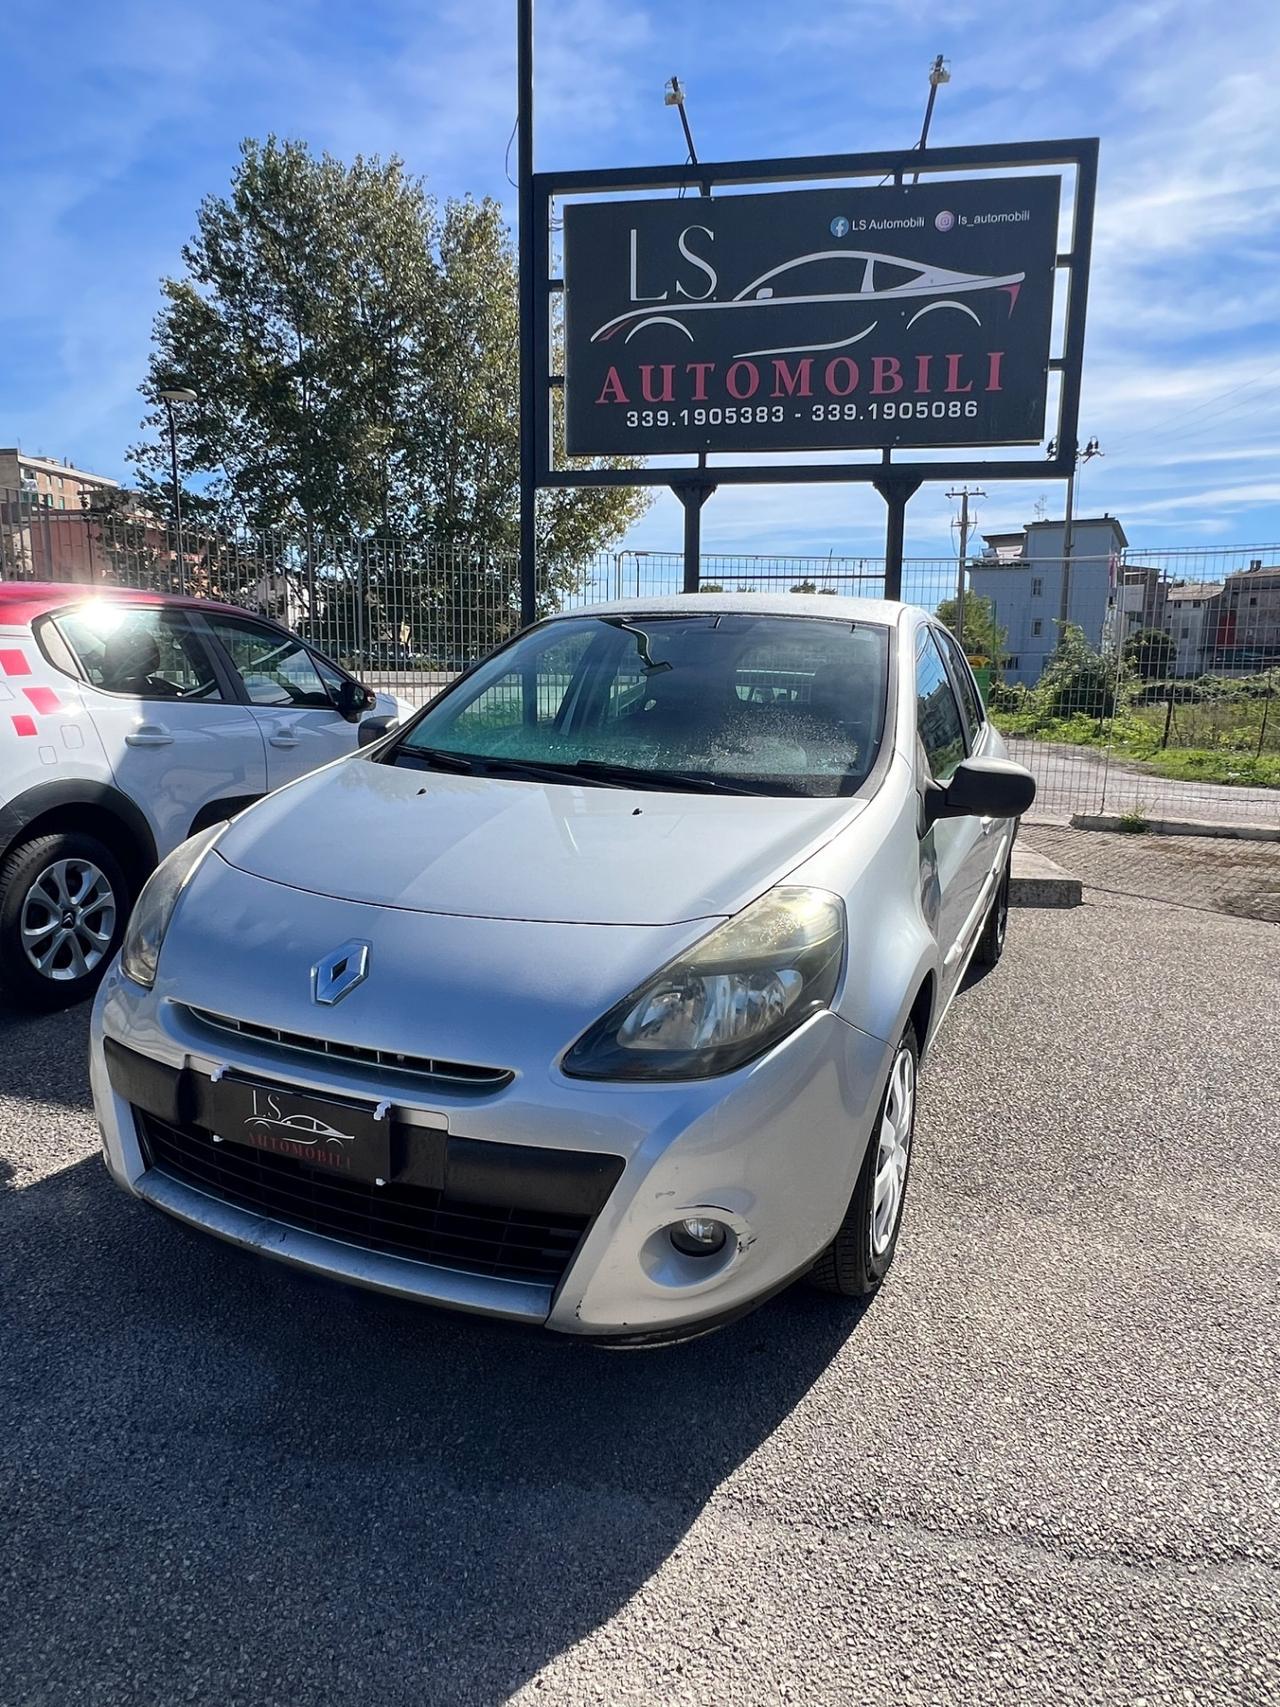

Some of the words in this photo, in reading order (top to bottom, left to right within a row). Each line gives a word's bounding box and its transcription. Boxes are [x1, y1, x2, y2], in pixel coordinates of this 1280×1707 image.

[852, 219, 867, 231] LS
[868, 217, 925, 230] Automobili
[597, 352, 1005, 404] AUTOMOBILI
[626, 406, 785, 428] 339.1905383
[811, 400, 978, 422] 339.1905086
